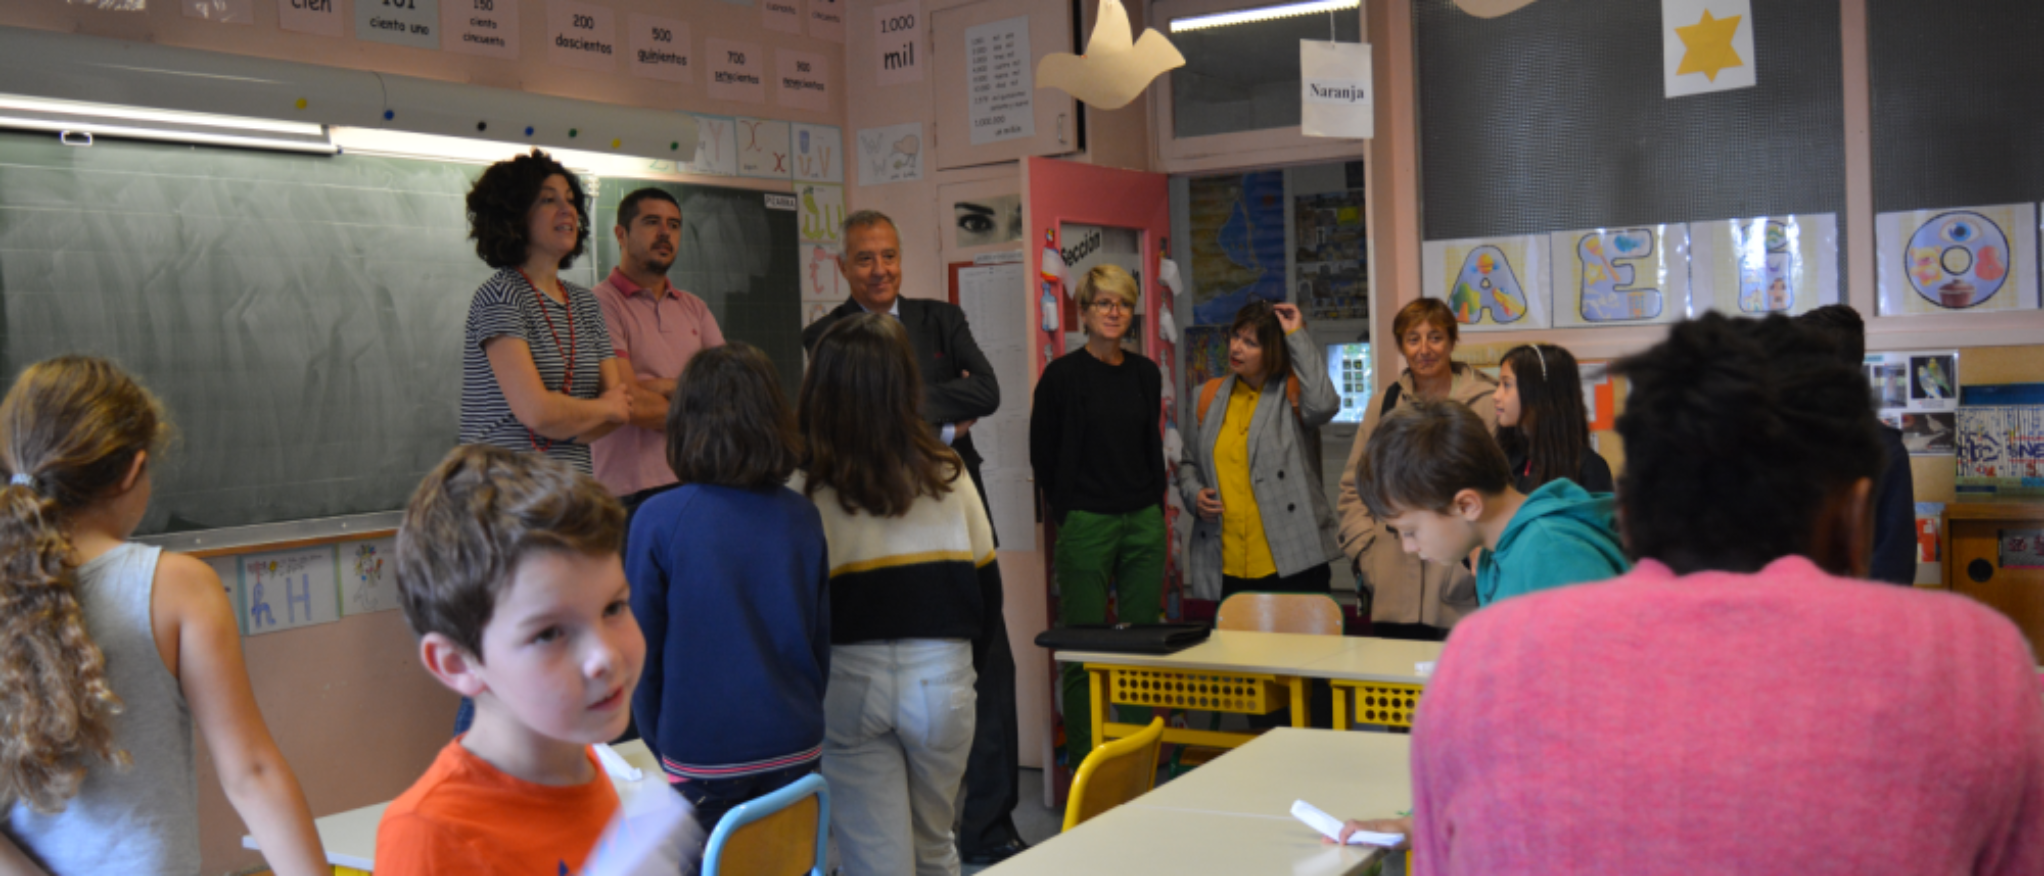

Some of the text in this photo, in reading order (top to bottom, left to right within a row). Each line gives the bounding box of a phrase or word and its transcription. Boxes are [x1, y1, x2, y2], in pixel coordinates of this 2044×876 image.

[369, 16, 430, 36] ciento uno
[469, 16, 498, 30] ciento
[572, 13, 595, 30] 200
[555, 33, 613, 55] doscientos
[651, 27, 673, 43] 500
[637, 49, 688, 67] quinientos
[726, 50, 746, 66] 700
[882, 41, 915, 71] mil
[1310, 83, 1365, 103] Naranja
[1061, 229, 1101, 268] Sección
[1448, 244, 1528, 325] A
[1577, 228, 1663, 323] E
[286, 573, 312, 624] H
